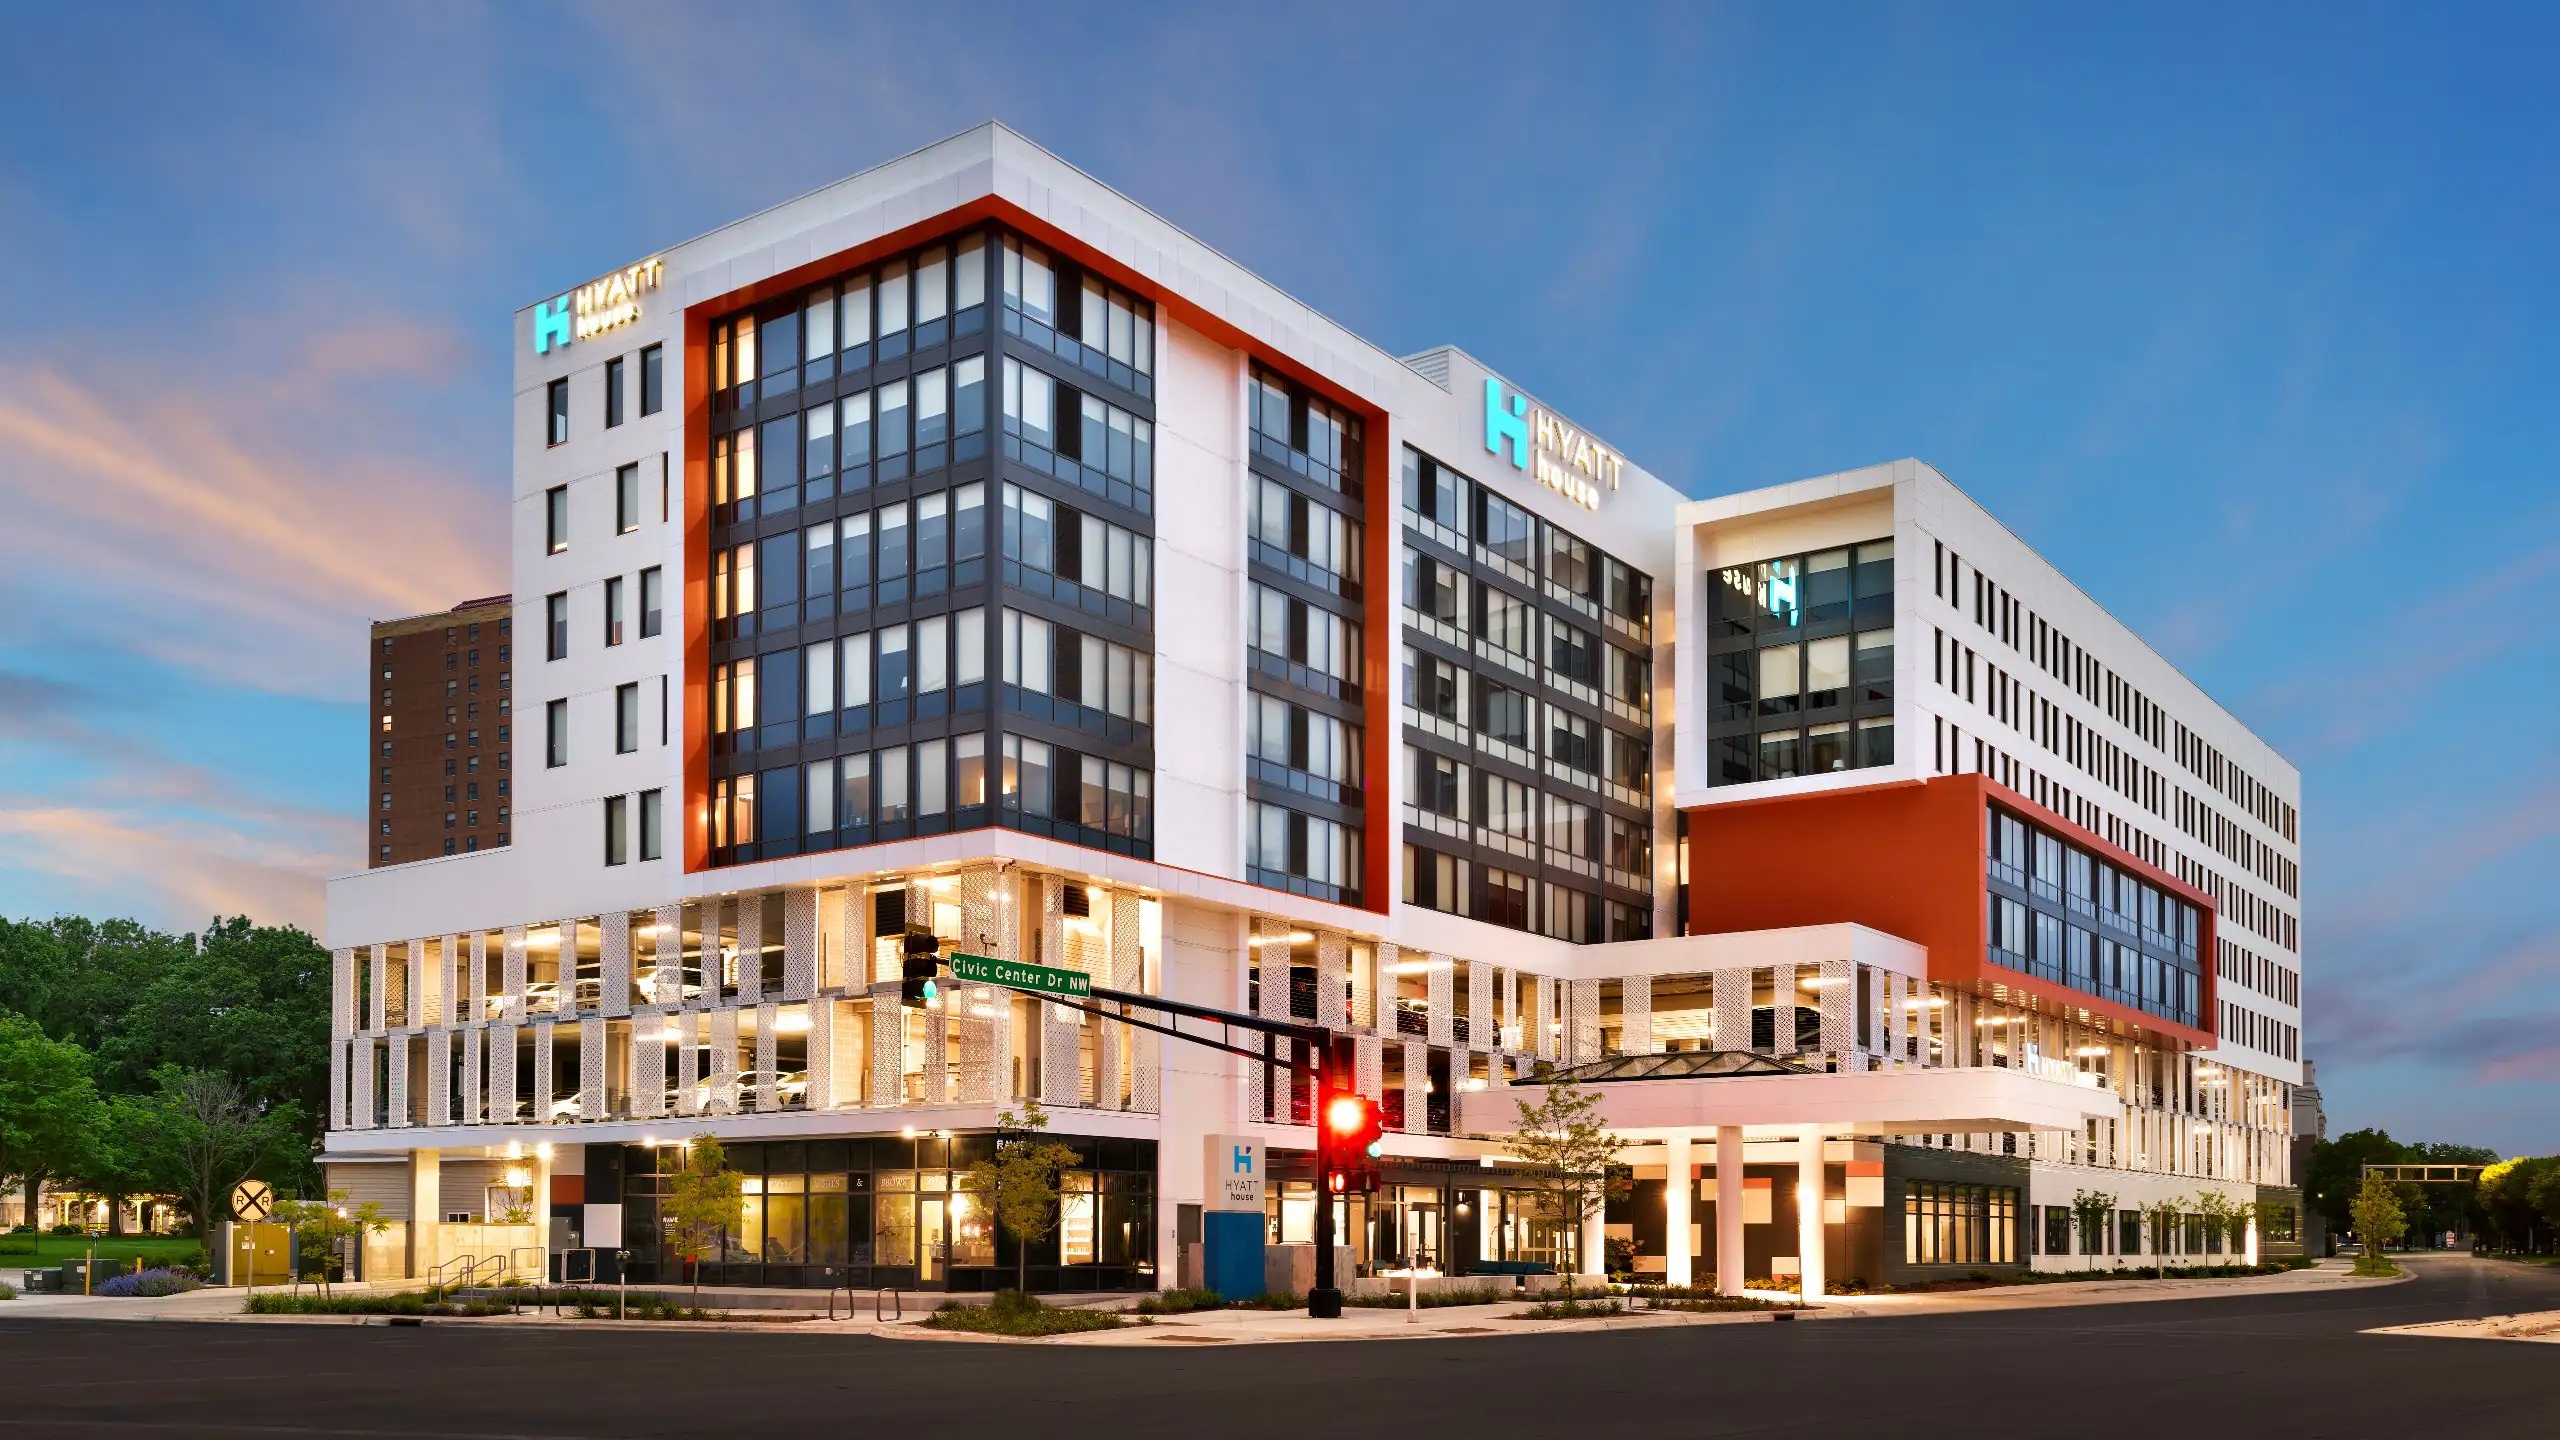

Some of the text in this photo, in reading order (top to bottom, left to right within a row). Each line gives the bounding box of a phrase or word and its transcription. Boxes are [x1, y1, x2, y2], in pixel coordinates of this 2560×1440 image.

[577, 259, 664, 316] HYATT
[1533, 409, 1623, 490] HYATT
[952, 958, 1088, 992] Civic Center Dr NW
[856, 1178, 863, 1187] &
[880, 1177, 908, 1187] BROWS
[1225, 1180, 1259, 1191] HYATT
[236, 1195, 270, 1206] R R
[1230, 1192, 1254, 1201] house
